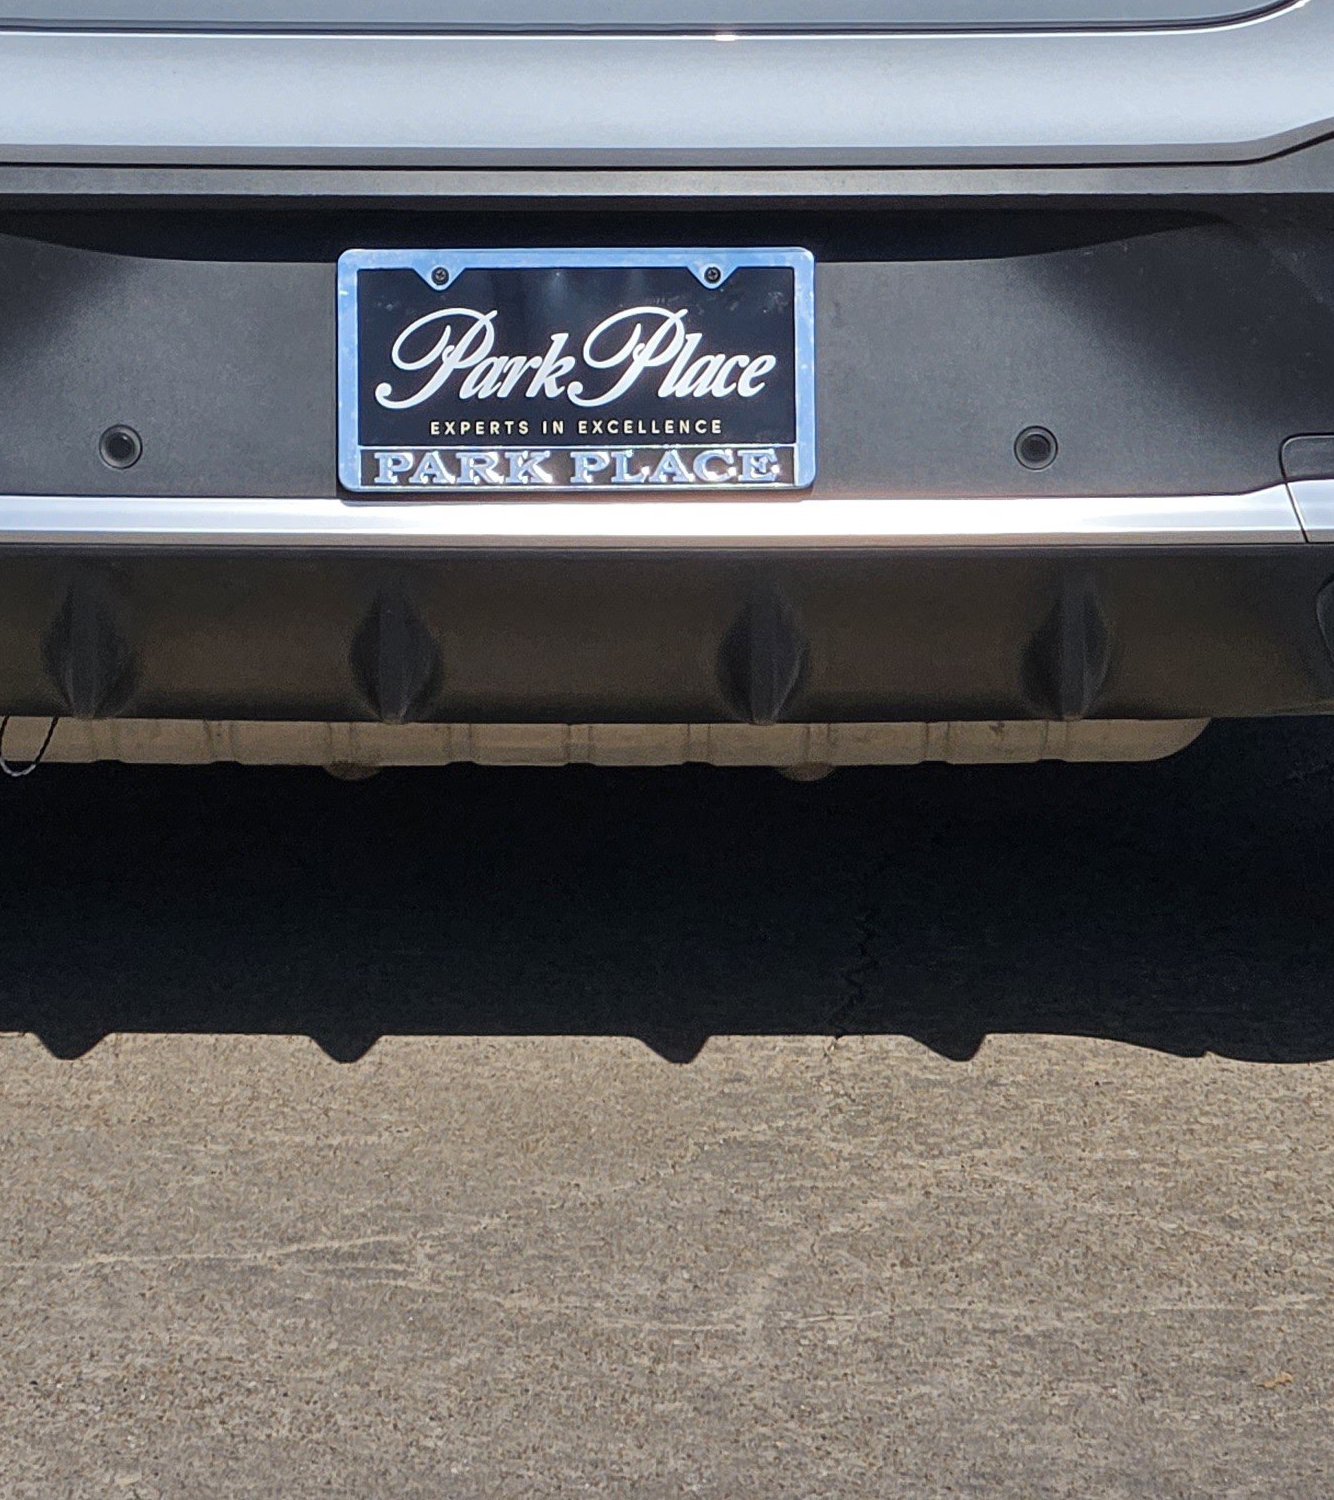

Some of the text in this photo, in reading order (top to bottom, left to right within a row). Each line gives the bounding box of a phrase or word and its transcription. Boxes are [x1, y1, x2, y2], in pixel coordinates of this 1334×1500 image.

[375, 306, 776, 409] Park Place
[430, 418, 722, 435] EXPERTS IN EXCELLENCE
[373, 448, 779, 485] PARK PLACE
